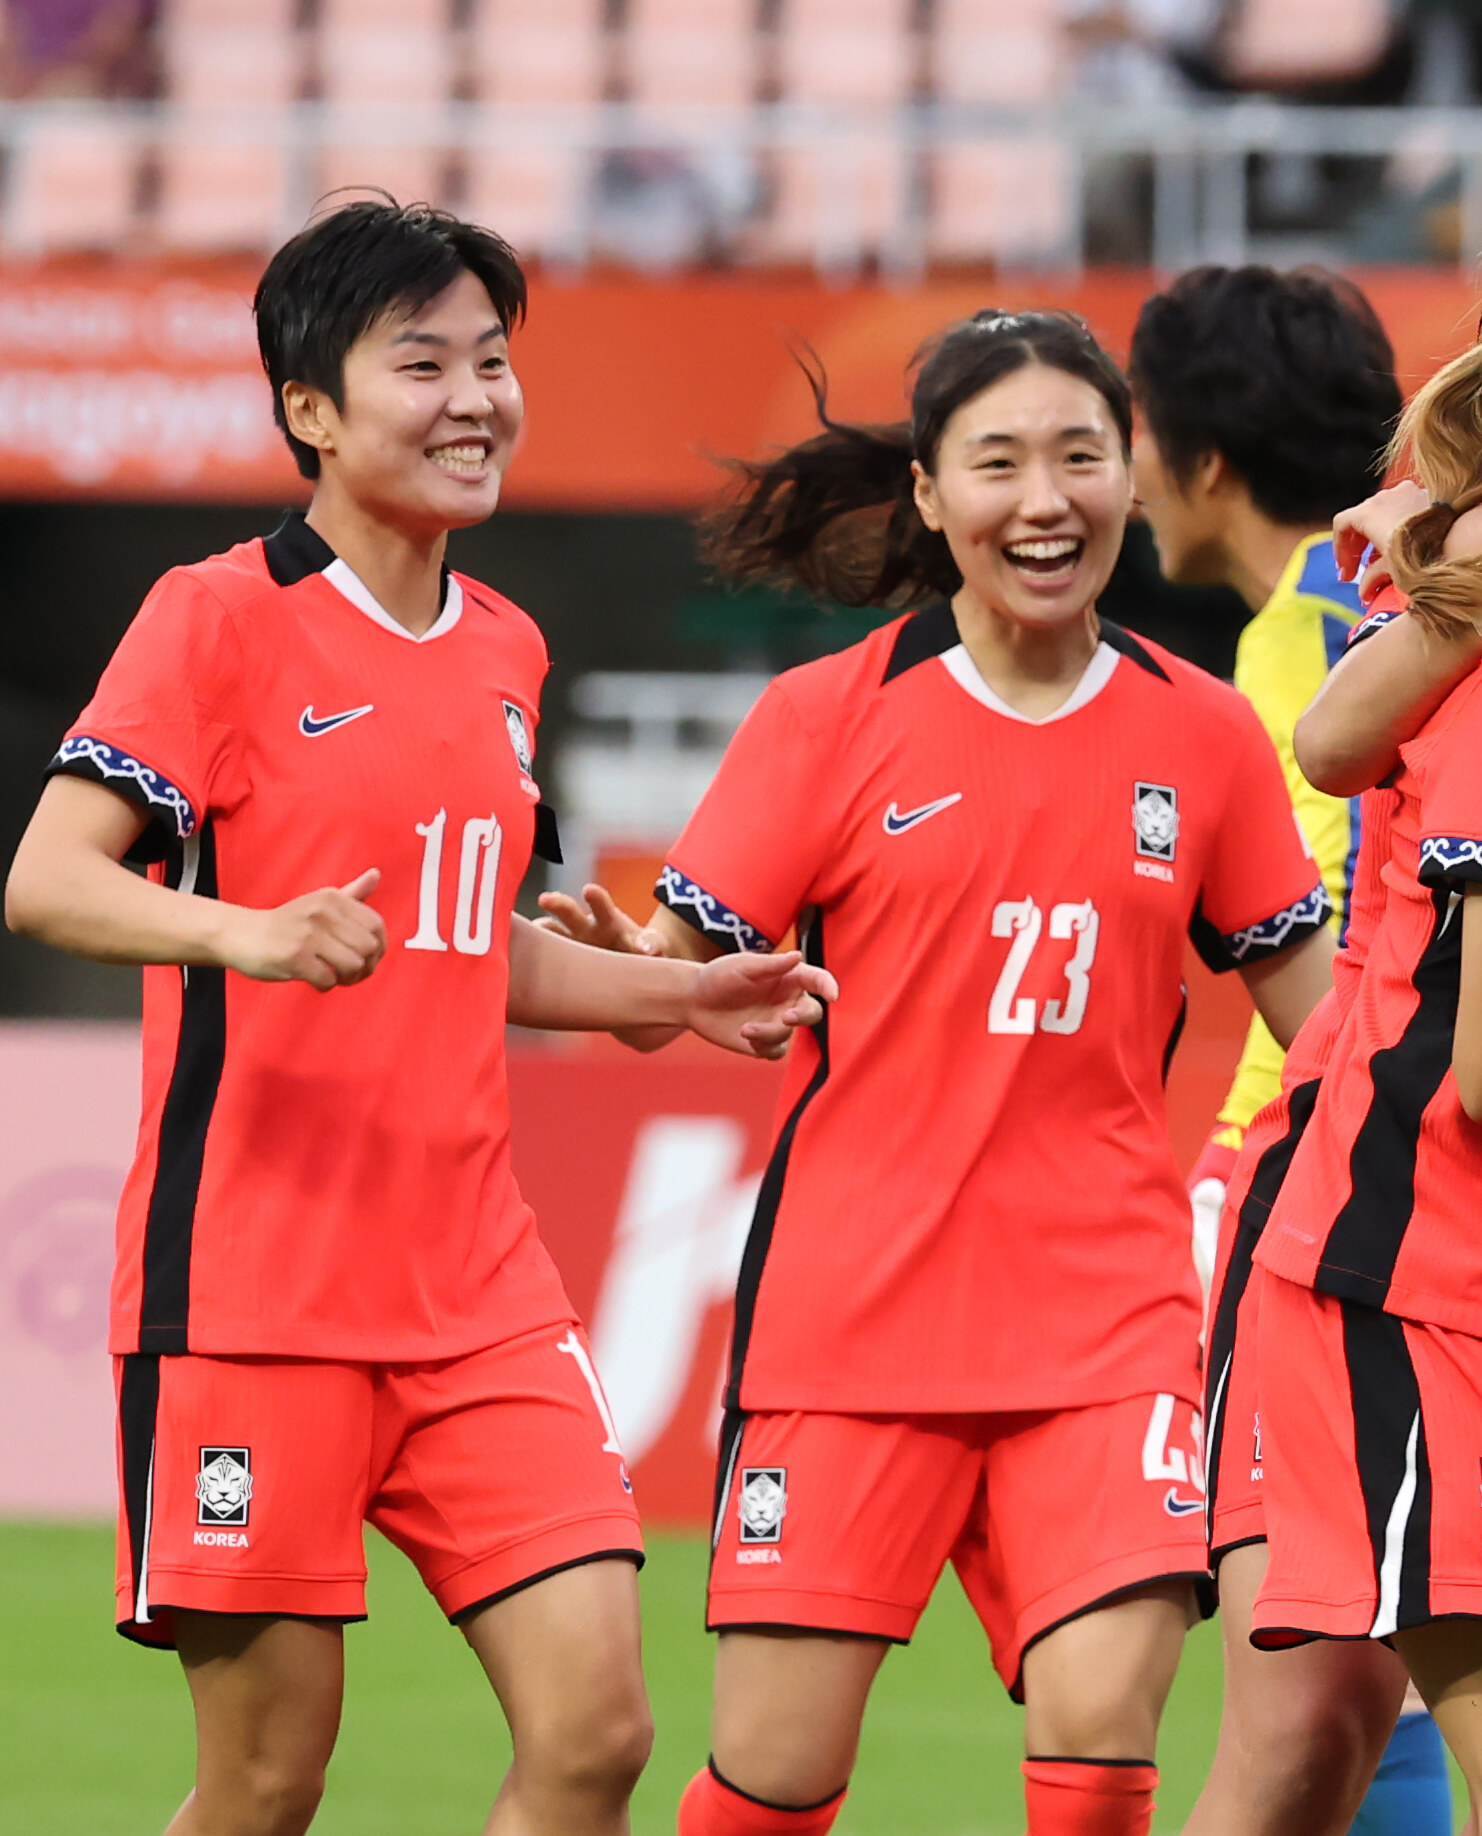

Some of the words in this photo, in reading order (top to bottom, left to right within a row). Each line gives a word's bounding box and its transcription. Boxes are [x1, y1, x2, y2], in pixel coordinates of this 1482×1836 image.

[404, 806, 503, 956] 10
[987, 894, 1100, 1036] 23
[193, 1531, 249, 1548] KOREA
[736, 1548, 783, 1565] KOREA
